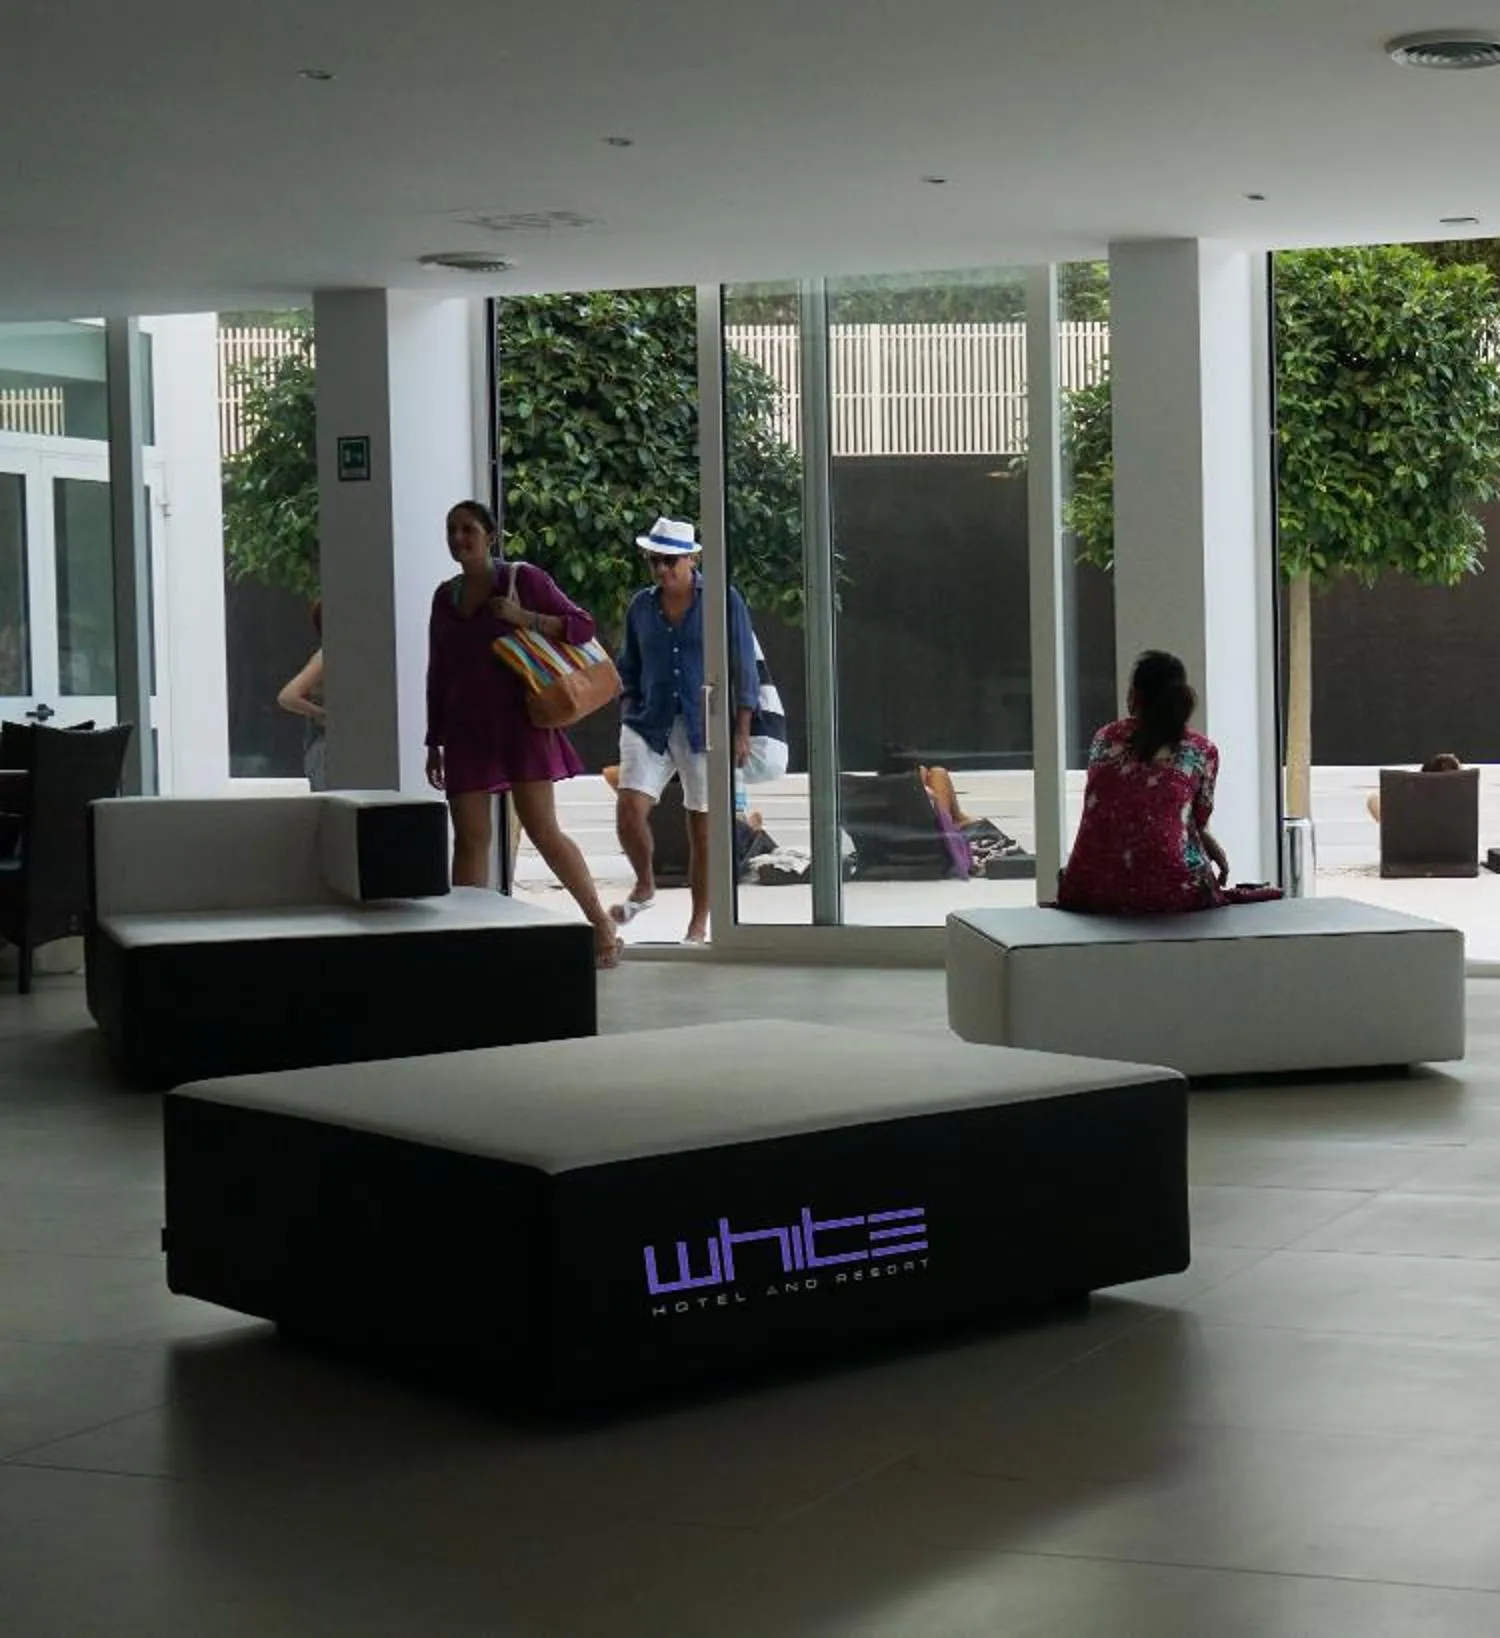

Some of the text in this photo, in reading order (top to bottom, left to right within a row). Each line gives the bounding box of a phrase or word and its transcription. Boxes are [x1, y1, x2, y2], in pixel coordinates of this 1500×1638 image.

[652, 1258, 928, 1316] HOTEL AND RESORT
